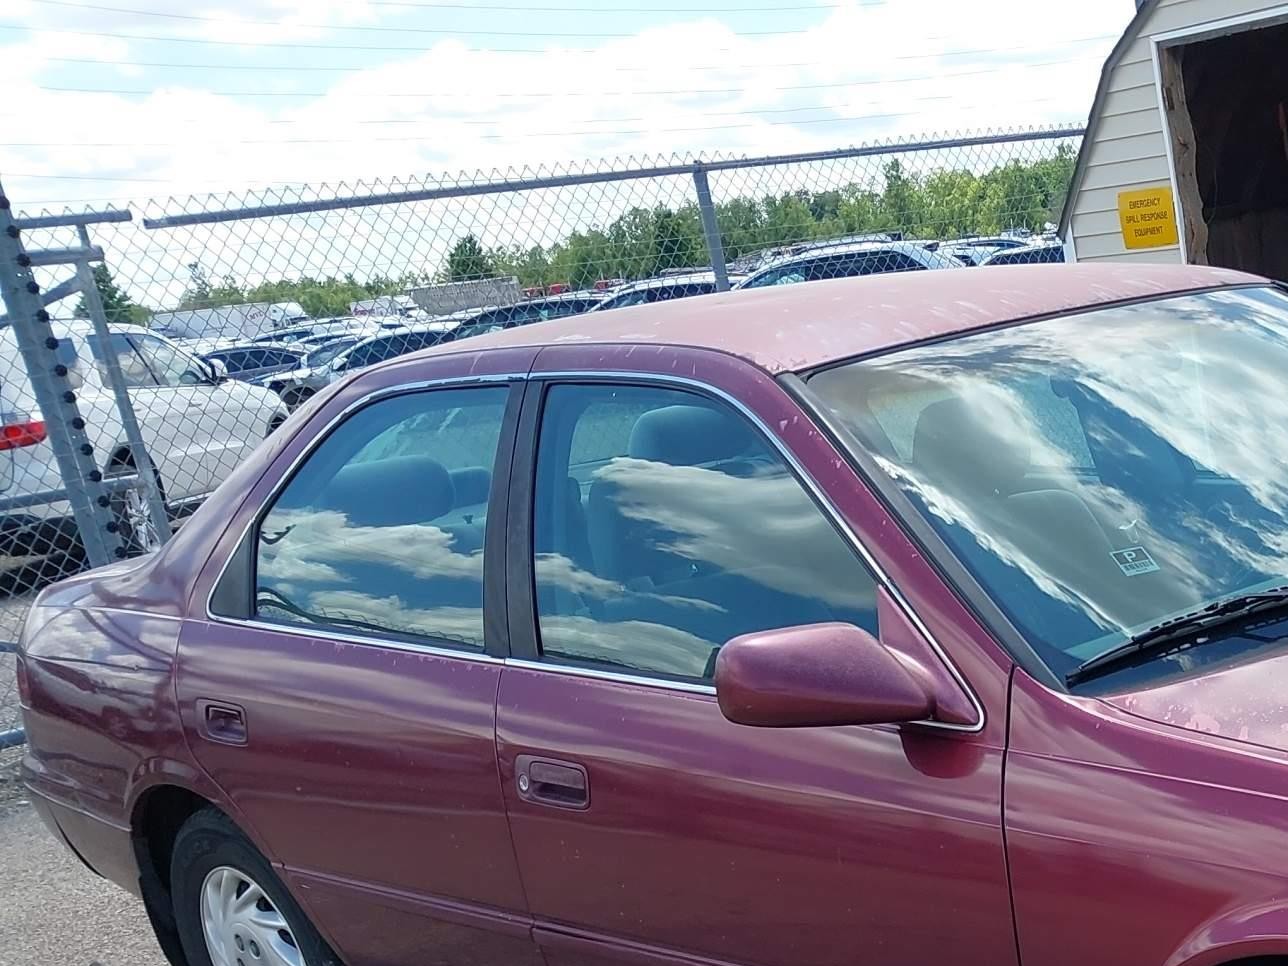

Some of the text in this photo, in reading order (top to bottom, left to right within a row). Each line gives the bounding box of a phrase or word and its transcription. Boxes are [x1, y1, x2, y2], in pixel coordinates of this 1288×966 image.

[1128, 198, 1160, 209] EMERGENCY
[1140, 211, 1168, 222] RESPONSE
[1134, 226, 1163, 237] EQUIPMENT
[1123, 551, 1136, 562] P
